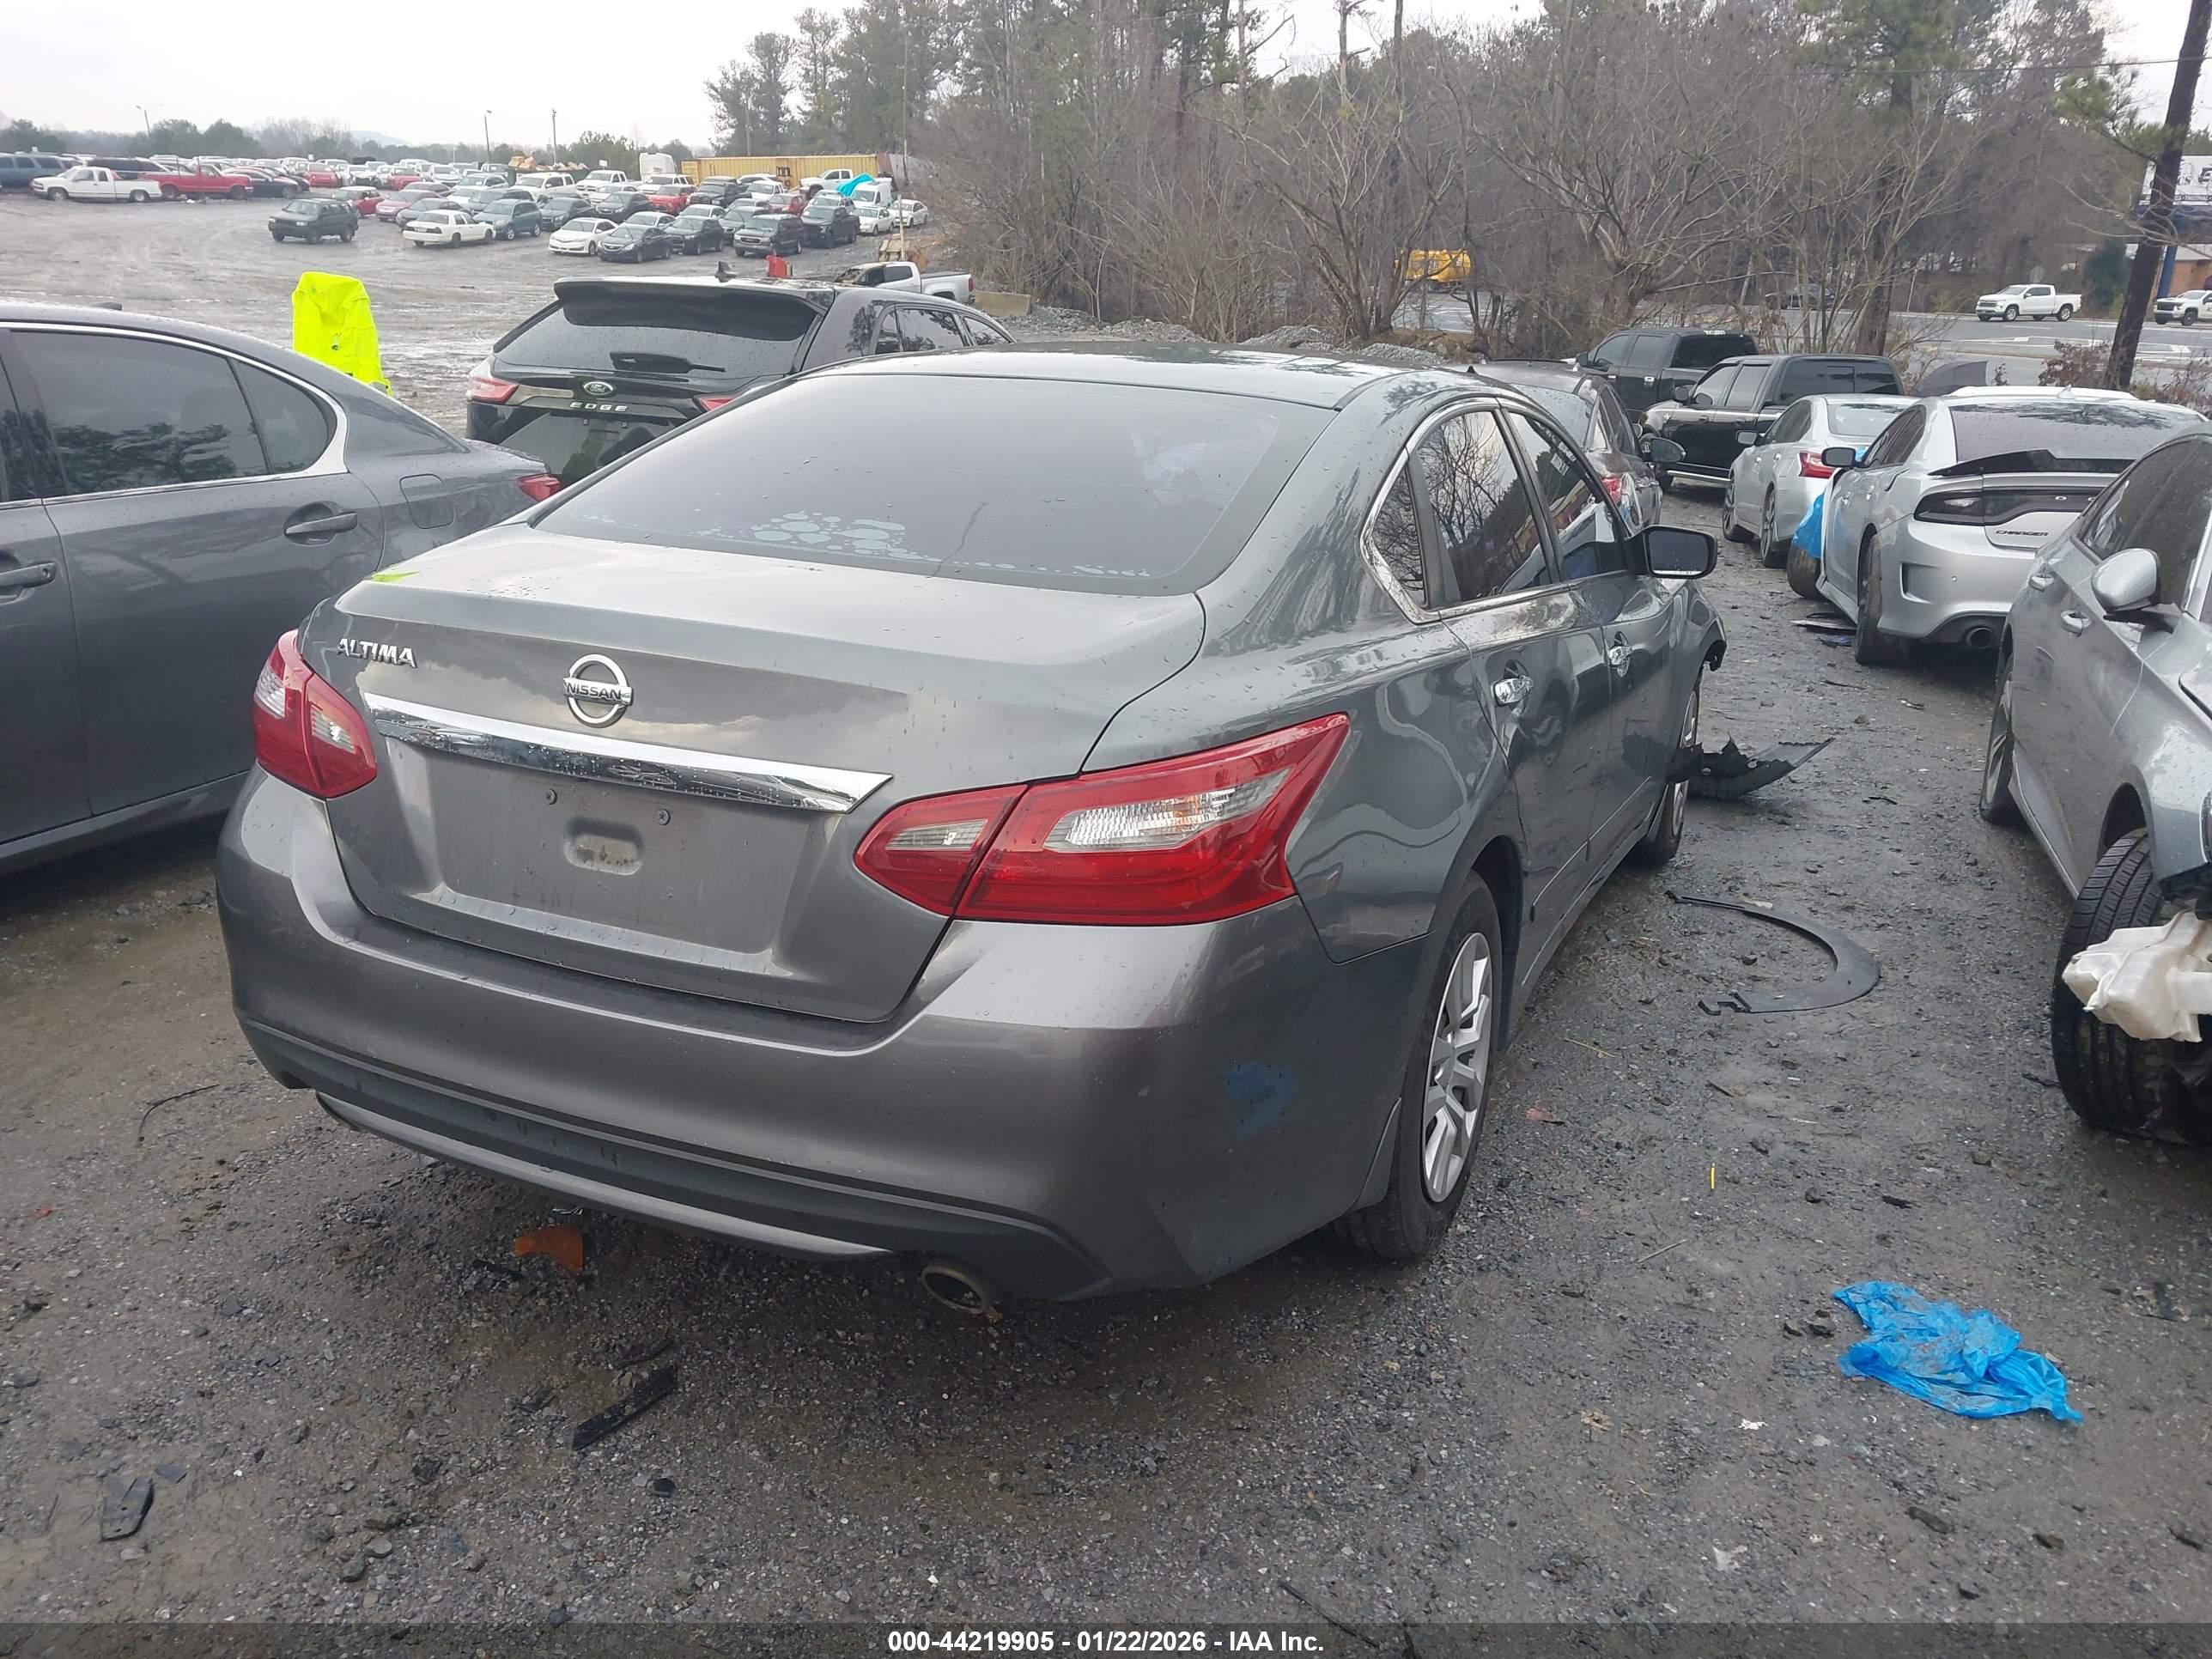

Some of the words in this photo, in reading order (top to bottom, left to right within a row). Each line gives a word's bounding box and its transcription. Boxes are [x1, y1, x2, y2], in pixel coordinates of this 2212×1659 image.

[570, 401, 628, 412] EDGE
[337, 638, 417, 668] ALTIMA
[566, 682, 622, 701] NISSAN
